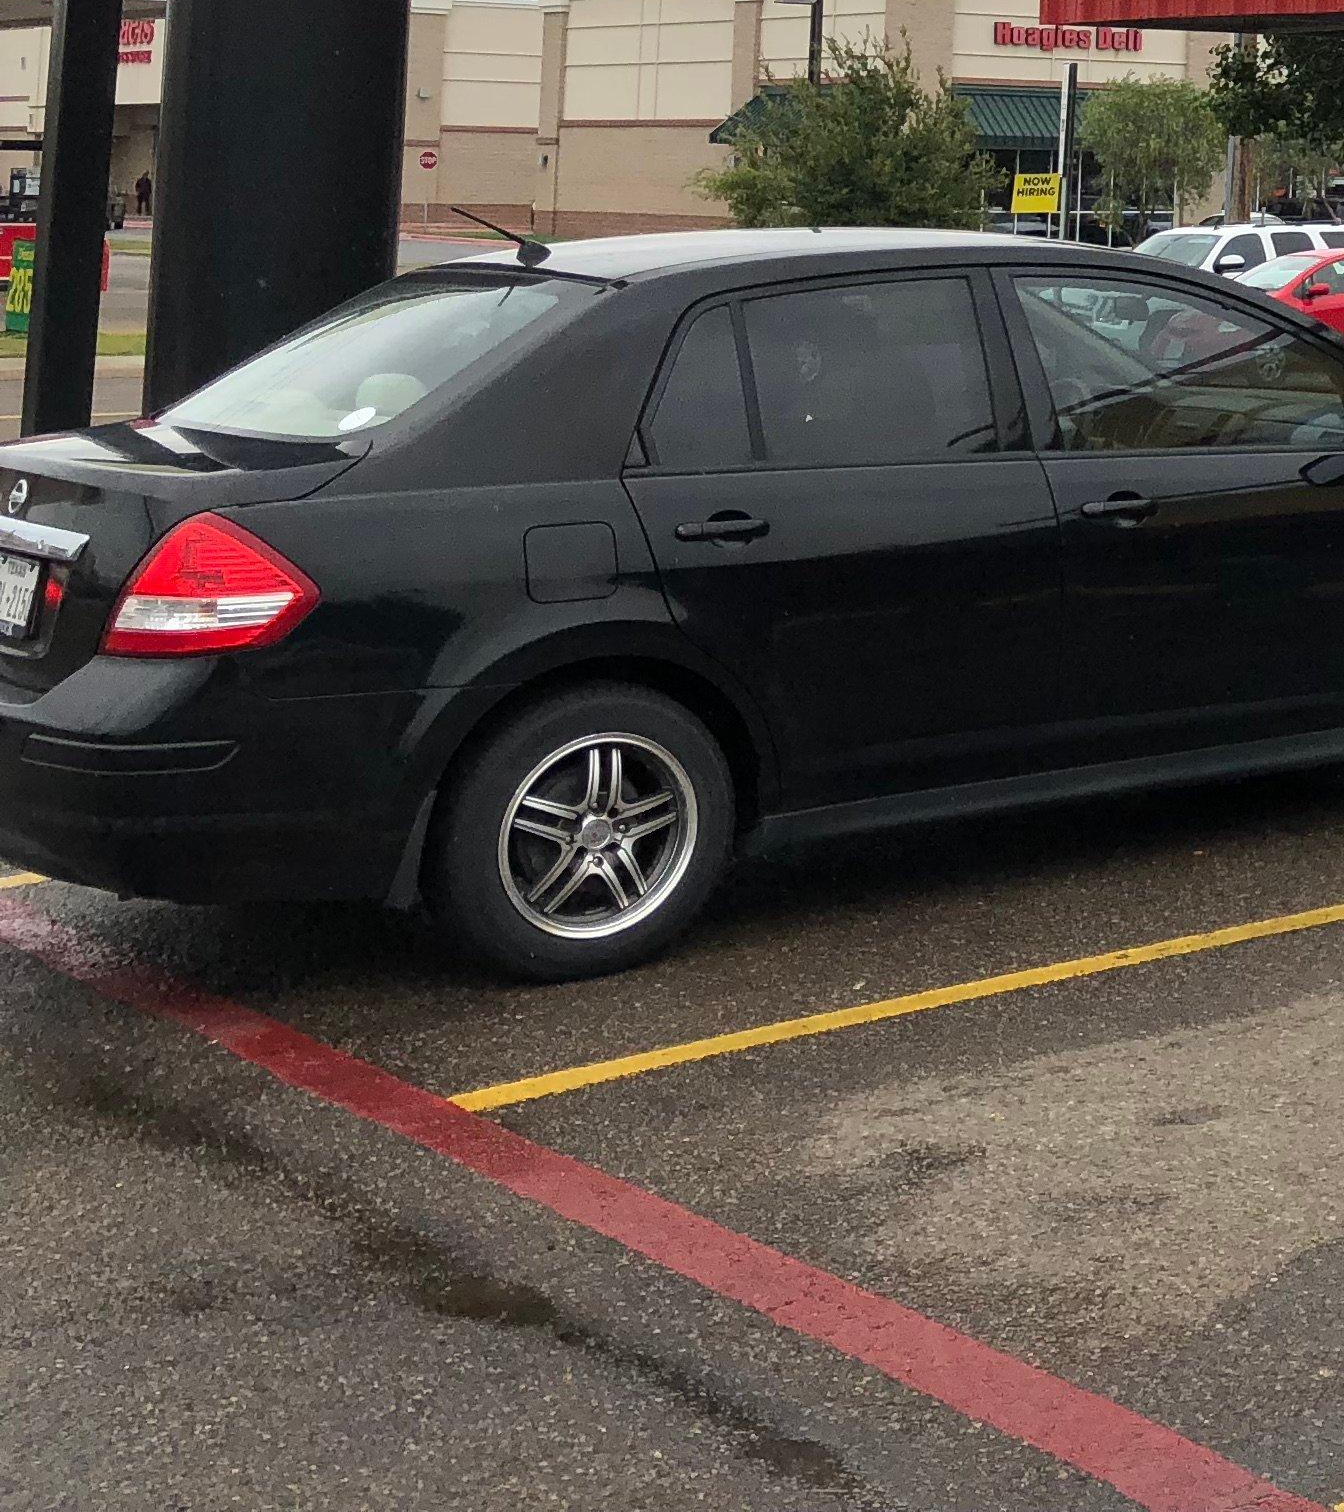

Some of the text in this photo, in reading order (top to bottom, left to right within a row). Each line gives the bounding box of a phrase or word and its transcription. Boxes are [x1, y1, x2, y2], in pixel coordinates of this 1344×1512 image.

[994, 21, 1143, 51] Hoagies Deli
[419, 156, 437, 164] STOP
[1022, 176, 1052, 186] NOW
[1016, 187, 1056, 197] HIRING
